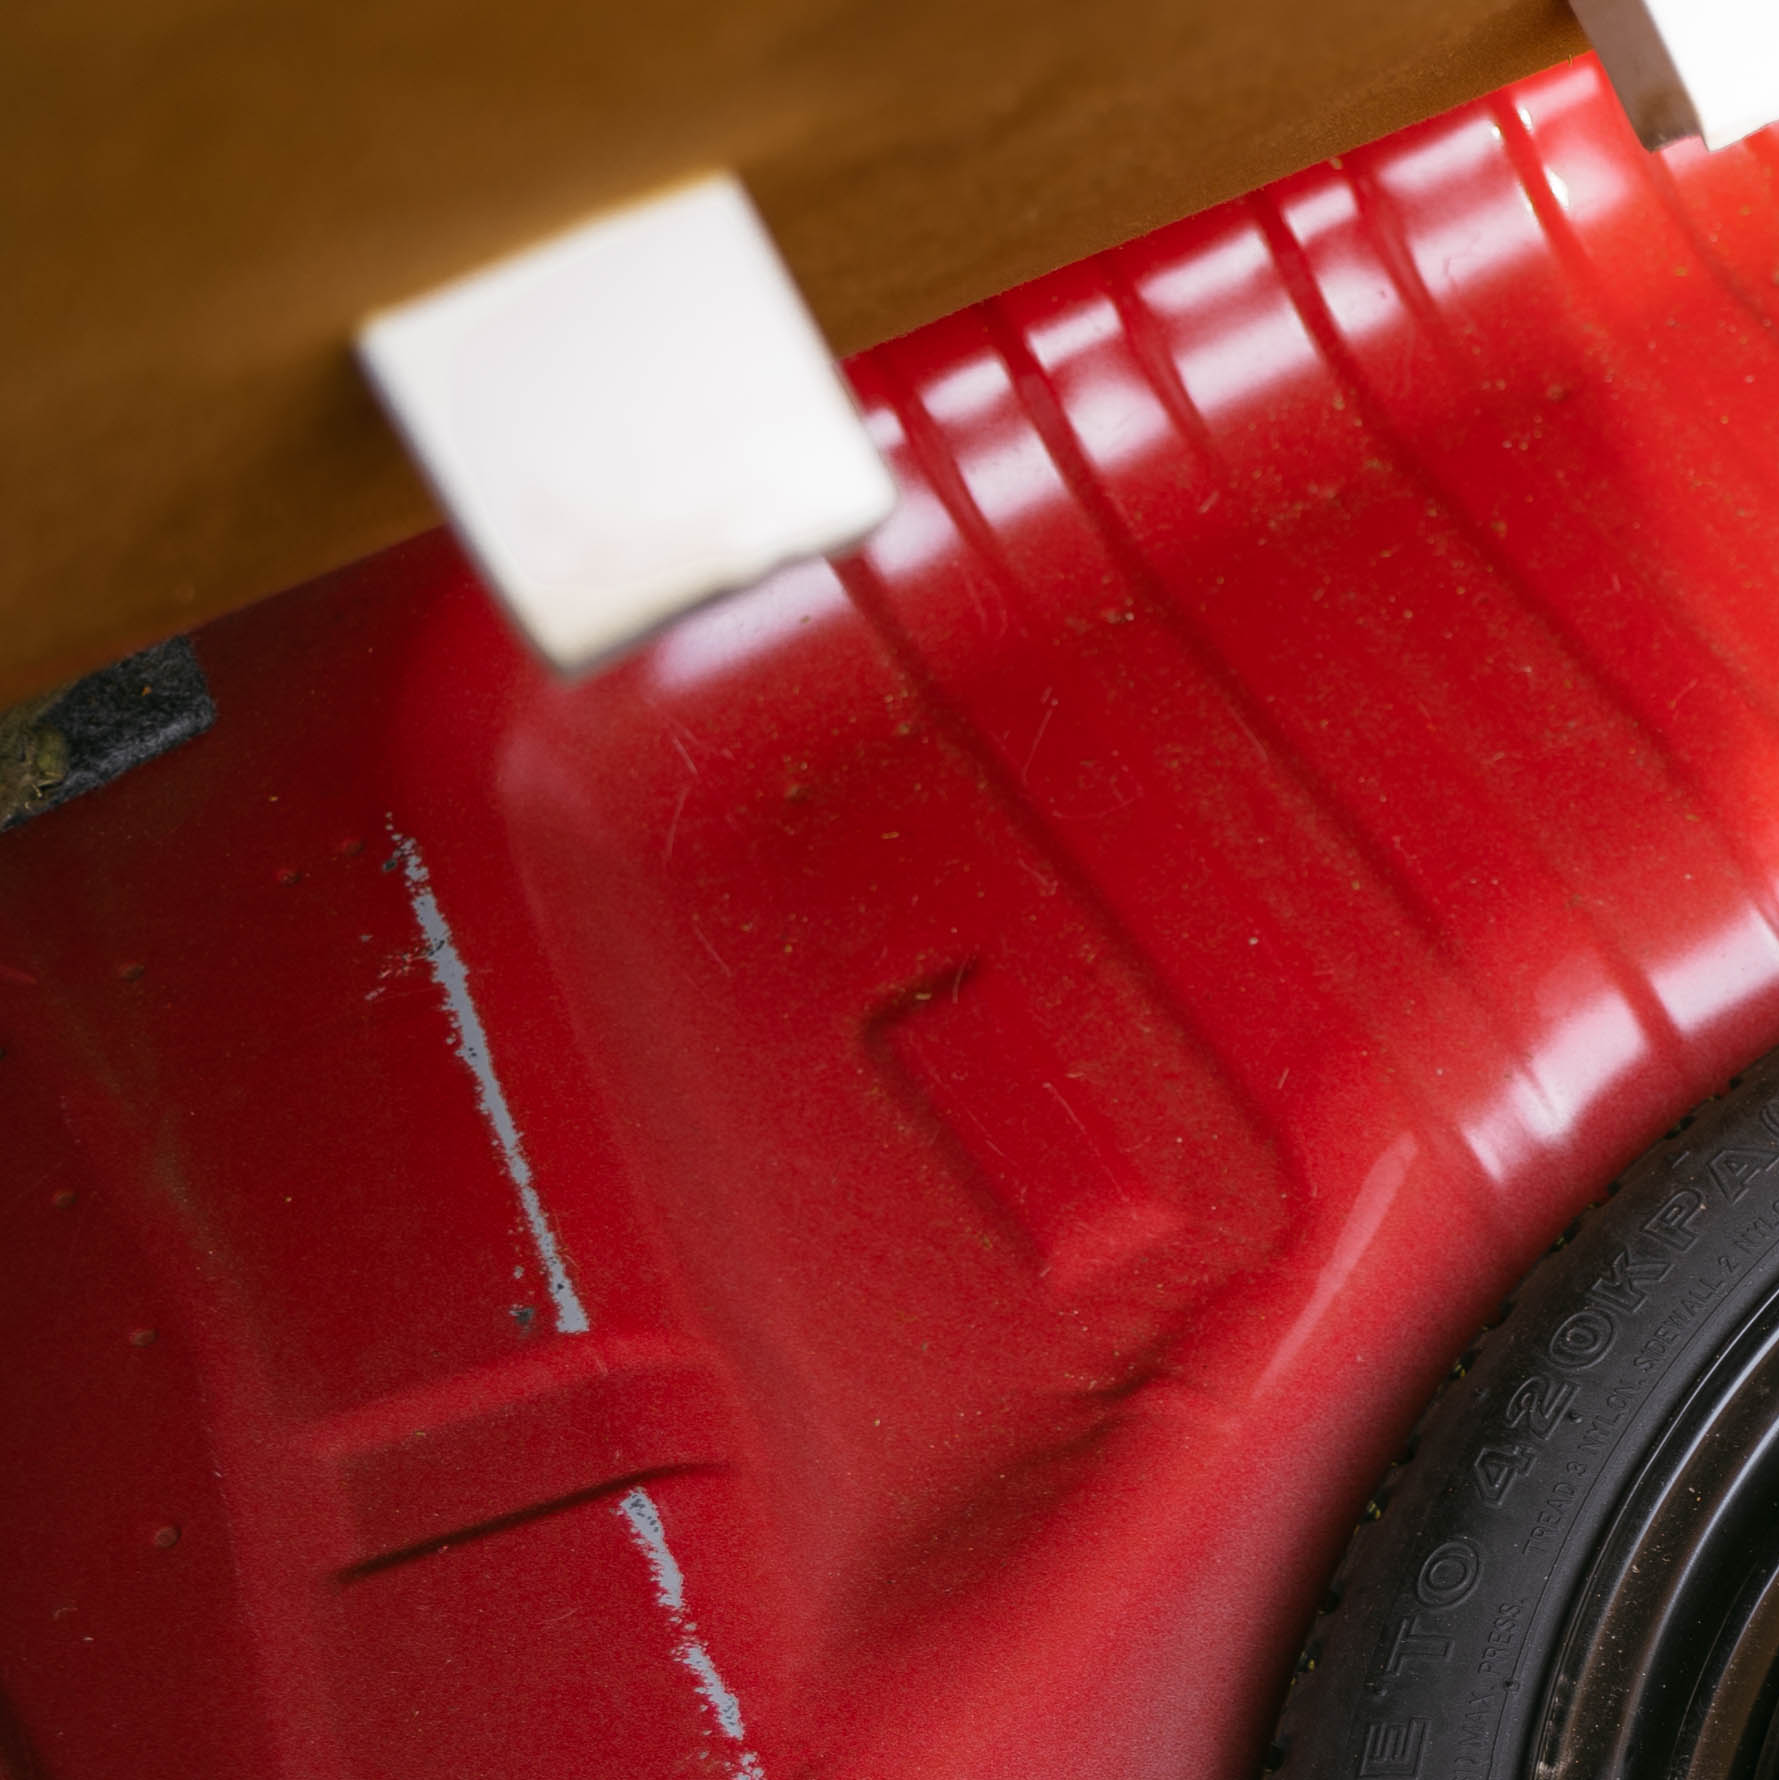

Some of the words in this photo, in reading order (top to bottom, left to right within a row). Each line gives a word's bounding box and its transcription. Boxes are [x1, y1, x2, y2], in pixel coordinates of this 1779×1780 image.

[1521, 1486, 1577, 1552] TREAD
[1631, 1278, 1722, 1373] SIDEWALL
[1384, 1539, 1483, 1688] TO
